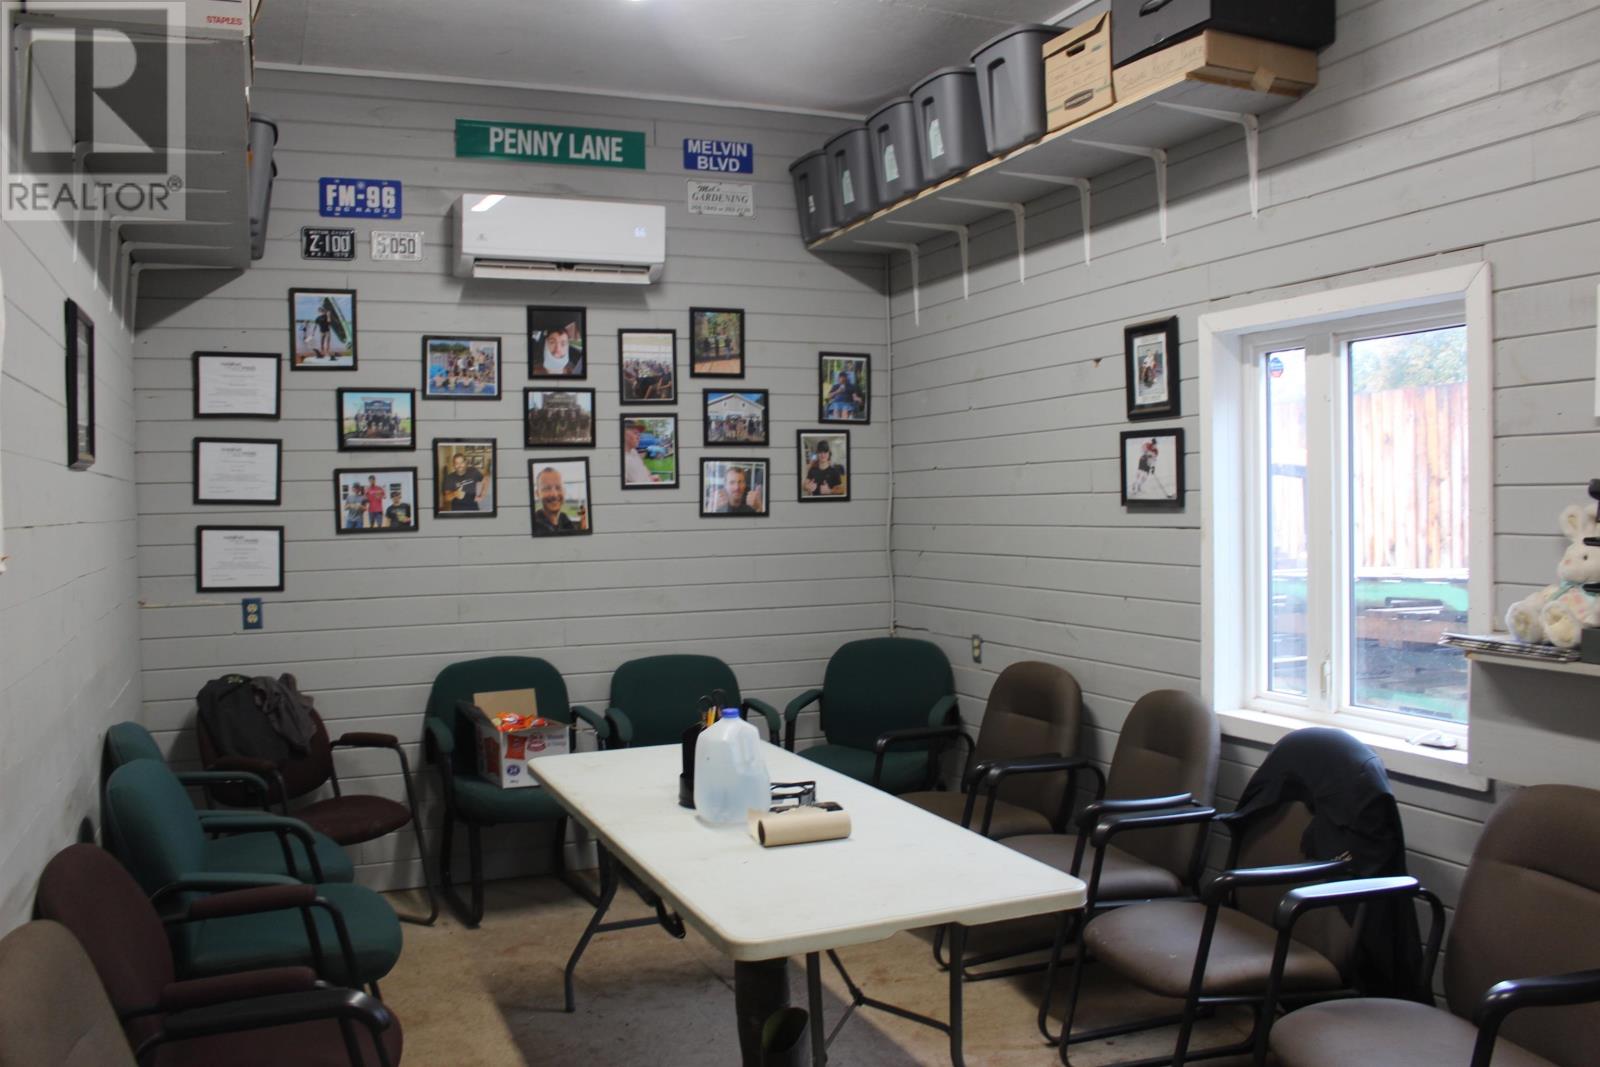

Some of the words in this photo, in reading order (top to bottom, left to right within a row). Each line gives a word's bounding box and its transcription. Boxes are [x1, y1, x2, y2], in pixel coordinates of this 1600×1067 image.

[206, 15, 243, 26] STAPLES
[488, 126, 564, 158] PENNY
[568, 133, 624, 162] LANE
[687, 139, 748, 158] MELVIN
[697, 155, 741, 172] BLVD
[326, 184, 396, 208] FM-96
[691, 192, 749, 204] GARDENING
[309, 234, 350, 253] Z-100
